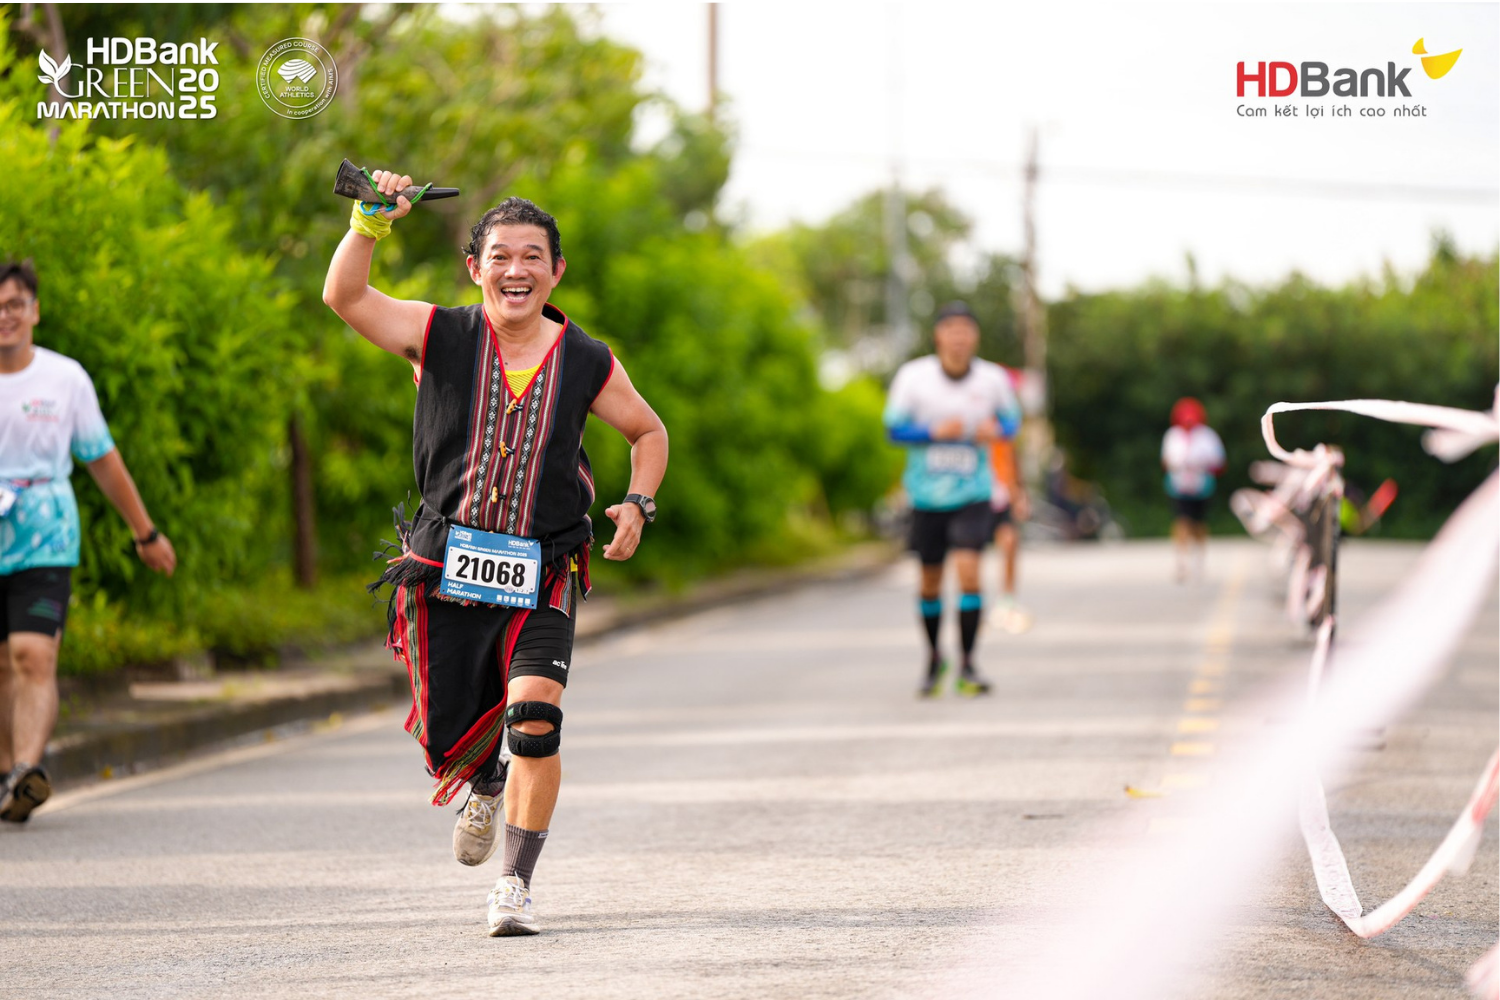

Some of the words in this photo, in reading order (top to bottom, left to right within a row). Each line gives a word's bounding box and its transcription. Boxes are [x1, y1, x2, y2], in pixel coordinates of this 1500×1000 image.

[508, 540, 530, 548] HDBank
[456, 554, 526, 587] 21068
[448, 581, 464, 589] HALF
[446, 588, 481, 599] MARATHON
